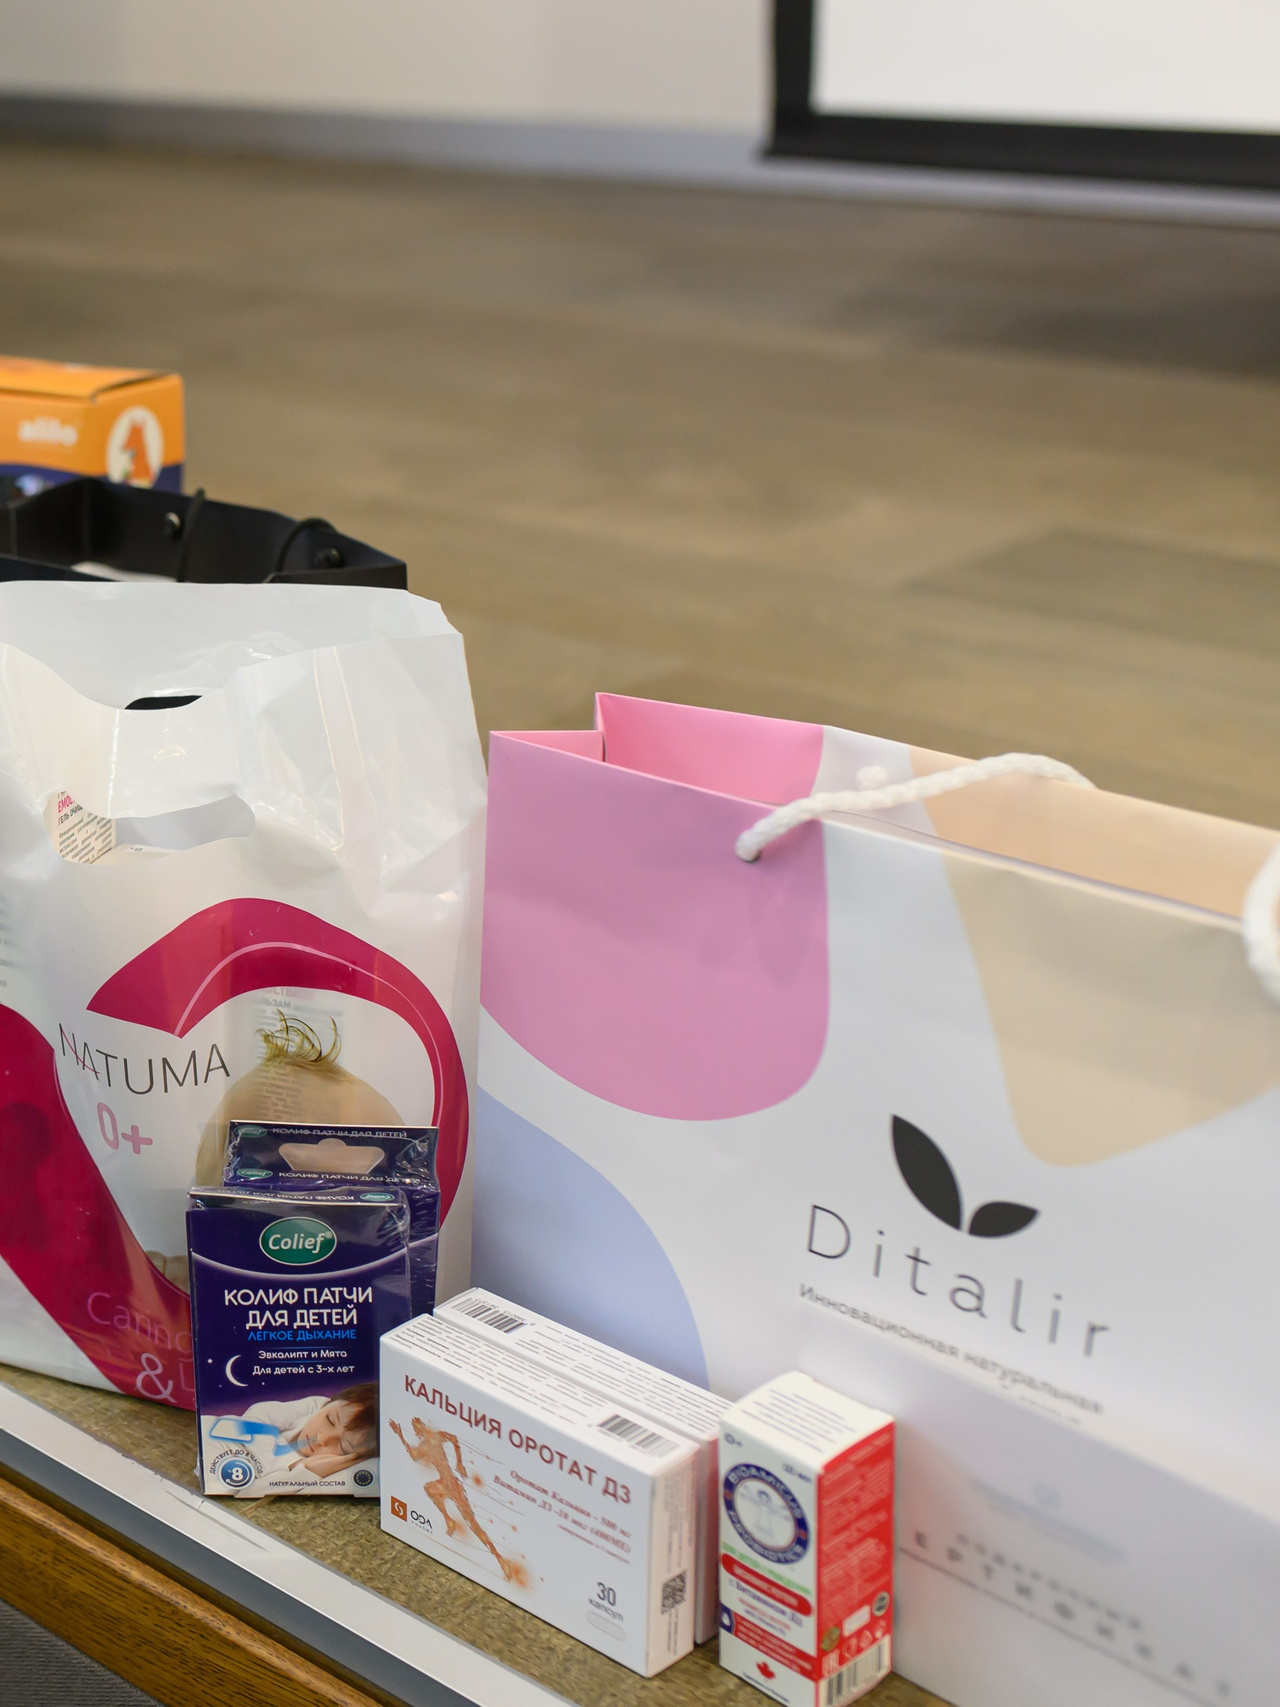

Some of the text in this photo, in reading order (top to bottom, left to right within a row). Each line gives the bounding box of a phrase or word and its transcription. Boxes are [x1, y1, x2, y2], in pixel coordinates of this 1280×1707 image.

[59, 1022, 231, 1095] NATUMA
[97, 1102, 153, 1155] 0+
[272, 1127, 310, 1135] КОЛИФ
[376, 1130, 407, 1138] ДЕТЕЙ
[268, 1233, 326, 1254] Colief
[808, 1204, 1110, 1358] Ditalir
[224, 1286, 373, 1306] КОЛИФ ПАТЧИ
[246, 1304, 357, 1329] ДЛЯ ДЕТЕЙ
[799, 1283, 960, 1358] Инновационная
[248, 1329, 357, 1341] ЛЕГКОЕ ДЫХАНИЕ
[258, 1350, 309, 1360] Эвкалипт
[320, 1350, 347, 1359] Мята
[252, 1366, 271, 1375] Для
[274, 1365, 305, 1375] детей
[316, 1365, 334, 1374] 3-х
[337, 1365, 355, 1373] лет
[404, 1374, 502, 1440] КАЛЬЦИЯ
[508, 1428, 597, 1486] ОРОТАТ
[600, 1475, 632, 1504] Д3
[231, 1467, 244, 1481] 8
[269, 1479, 318, 1487] НАТУРАЛЬНЫЙ
[596, 1581, 617, 1607] 30
